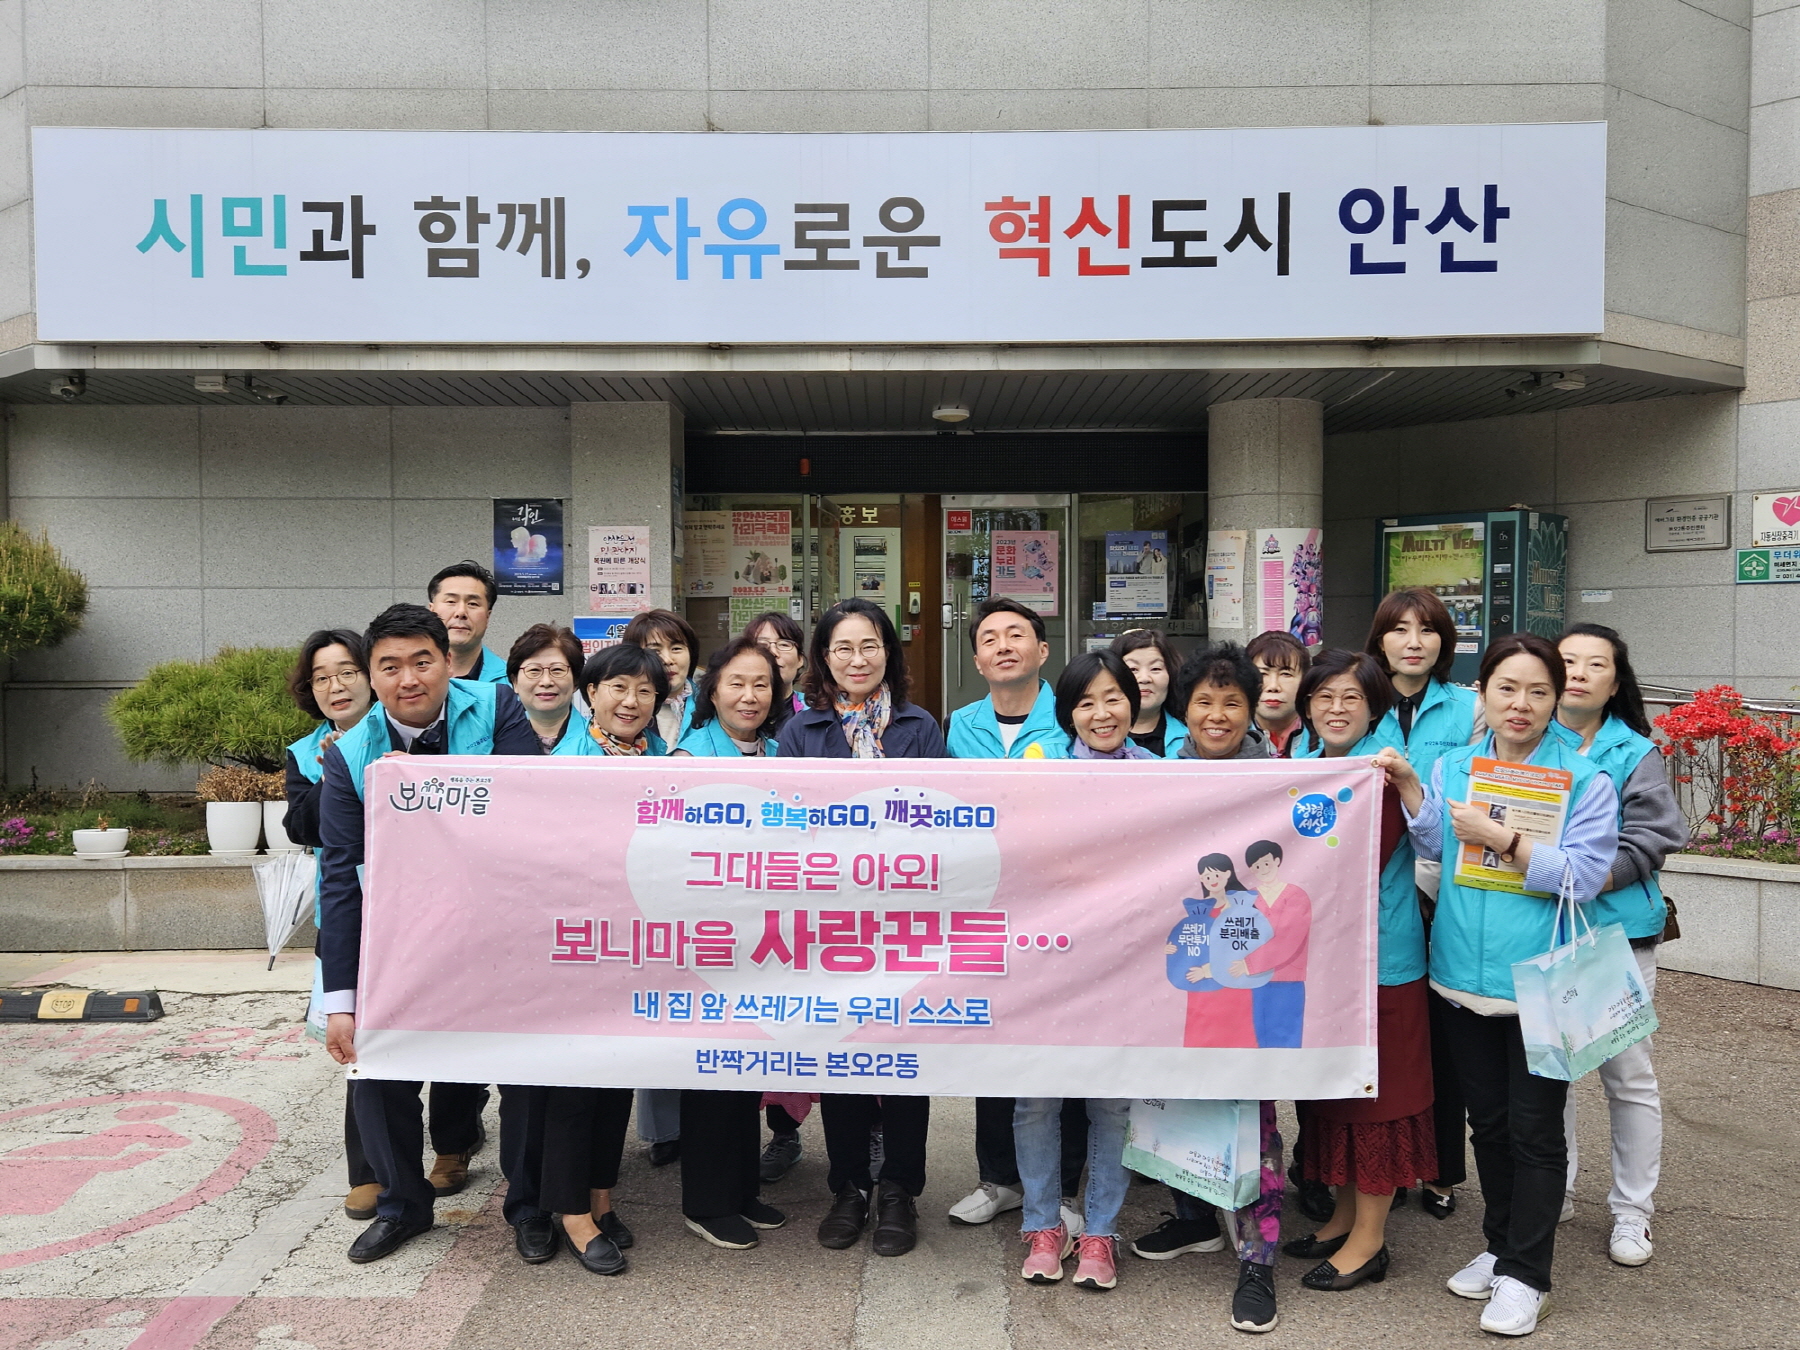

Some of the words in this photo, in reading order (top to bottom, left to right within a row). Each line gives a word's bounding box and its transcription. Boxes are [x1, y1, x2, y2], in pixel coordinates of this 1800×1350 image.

[136, 194, 376, 279] 시민과
[413, 196, 591, 280] 함께,
[623, 196, 941, 280] 자유로운
[984, 192, 1290, 277] 혁신도시
[1338, 184, 1510, 275] 안산
[1760, 530, 1799, 542] 자동심장충격기
[996, 546, 1017, 555] 문화
[996, 556, 1016, 566] 누리
[996, 566, 1016, 576] 카드
[389, 782, 490, 815] 보니마을
[636, 798, 754, 829] 함께하GO,
[761, 799, 877, 831] 행복하GO,
[883, 798, 997, 831] 깨끗하GO
[1299, 816, 1328, 834] 세상
[685, 850, 841, 892] 그대들은
[851, 852, 940, 893] 아오!
[1224, 917, 1255, 927] 쓰레기
[1182, 923, 1206, 935] 쓰레기
[1219, 928, 1260, 939] 분리배출
[550, 917, 739, 969] 보니마을
[1177, 935, 1209, 946] 무단투기
[1231, 940, 1248, 951] OK
[1187, 946, 1200, 956] NO
[54, 1000, 73, 1009] STOP
[631, 990, 662, 1020] 내
[667, 990, 693, 1021] 집
[699, 991, 727, 1022] 앞
[731, 992, 840, 1025] 쓰레기는
[846, 994, 900, 1026] 우리
[907, 996, 993, 1028] 스스로
[696, 1048, 819, 1078] 반짝거리는
[825, 1052, 920, 1080] 본오2동
